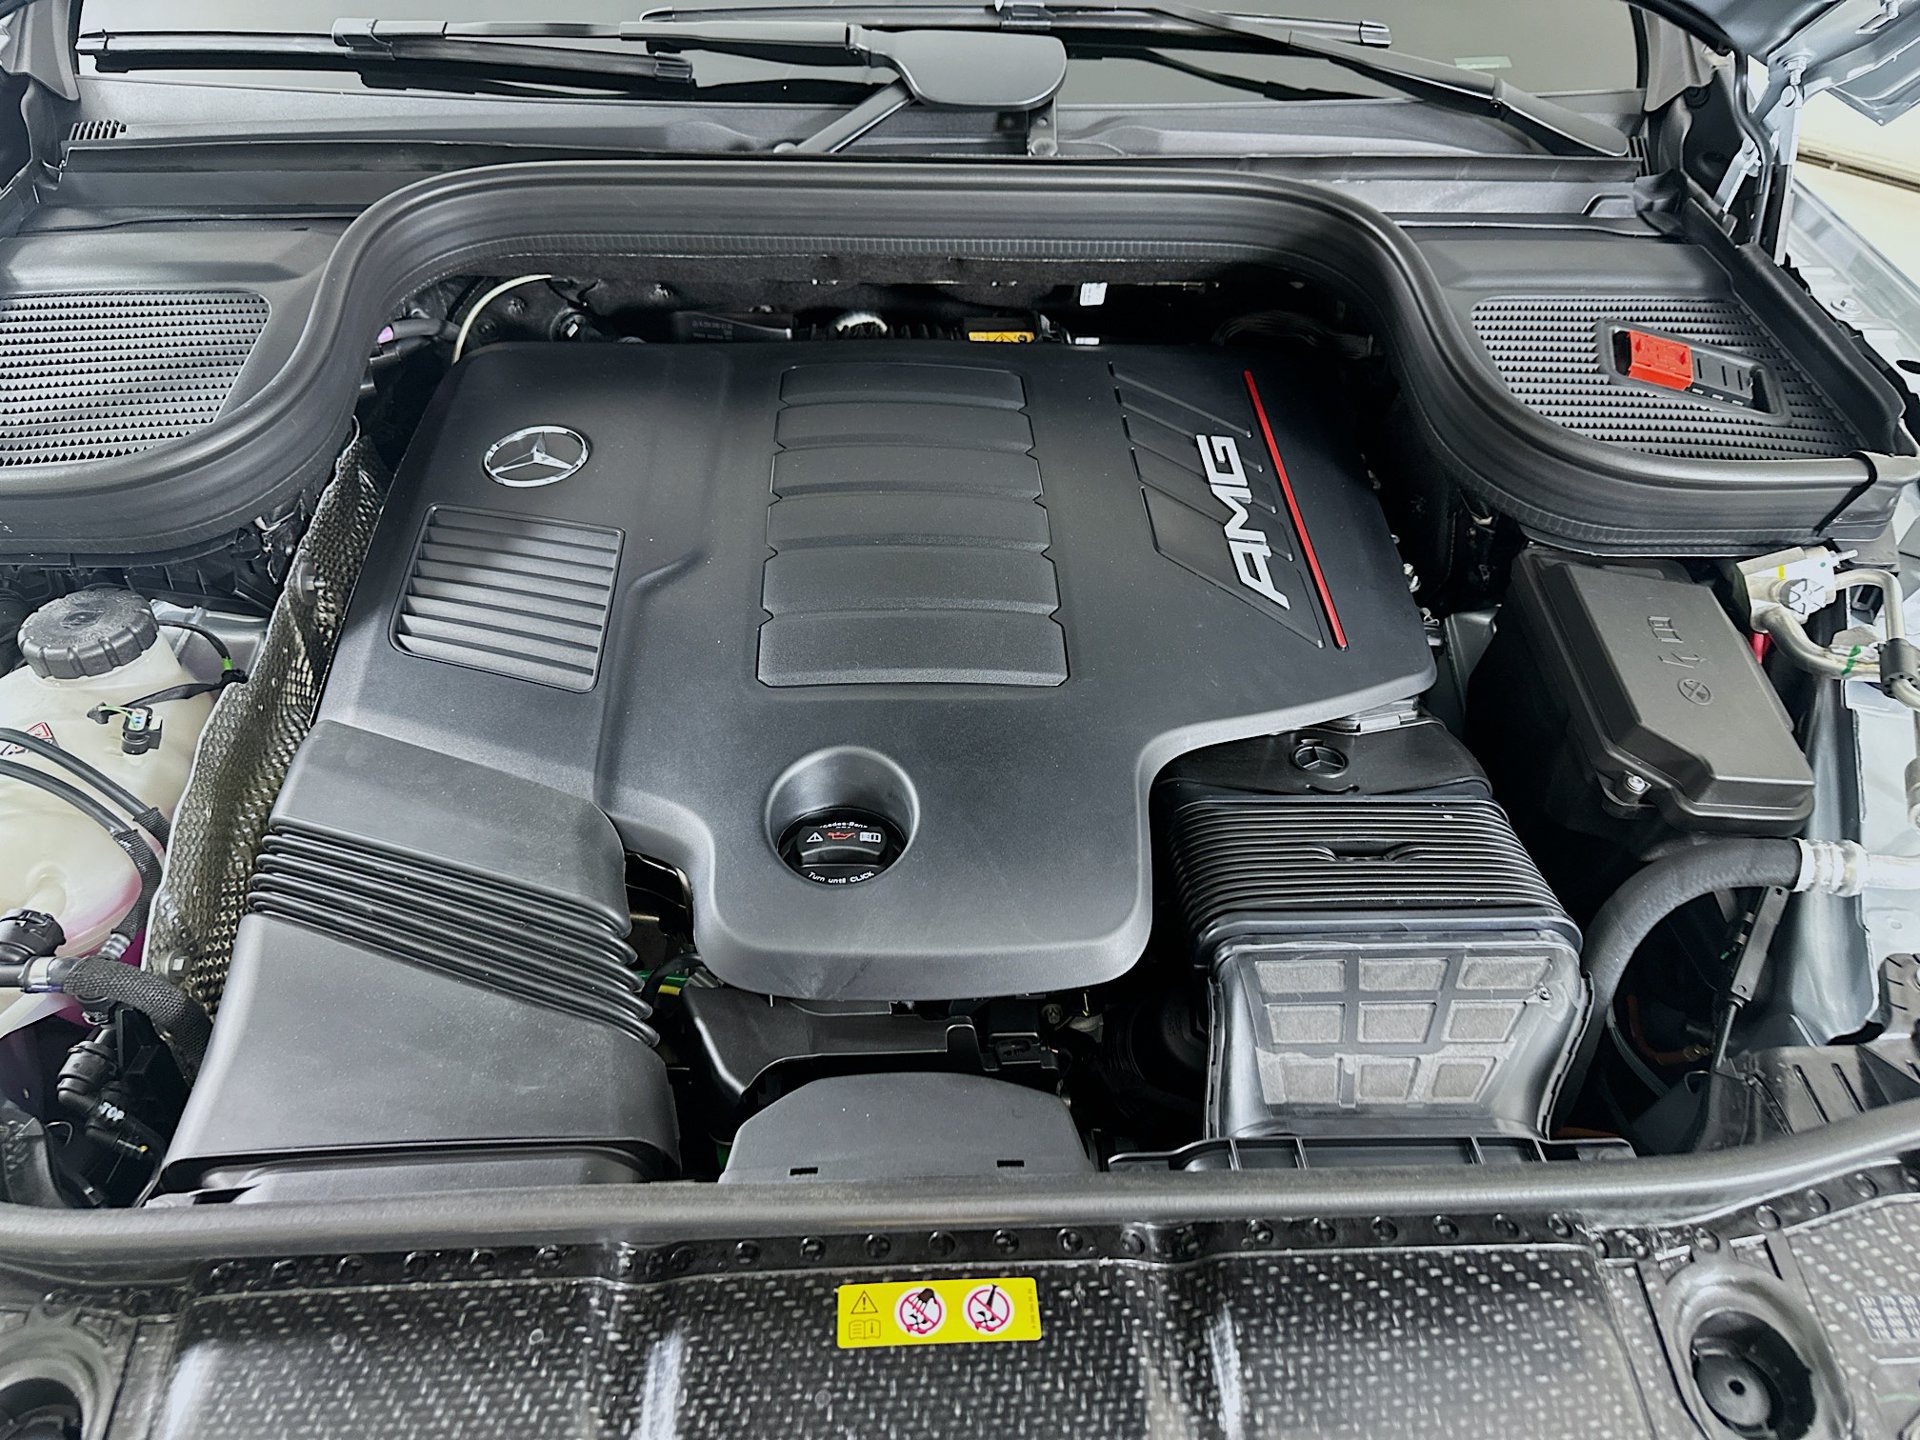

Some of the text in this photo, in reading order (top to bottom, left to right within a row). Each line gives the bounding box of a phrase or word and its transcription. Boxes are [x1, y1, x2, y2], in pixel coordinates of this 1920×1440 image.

[1196, 435, 1290, 610] AMG
[808, 872, 825, 882] Turn
[849, 870, 875, 883] CLICK
[98, 1101, 125, 1121] TOP
